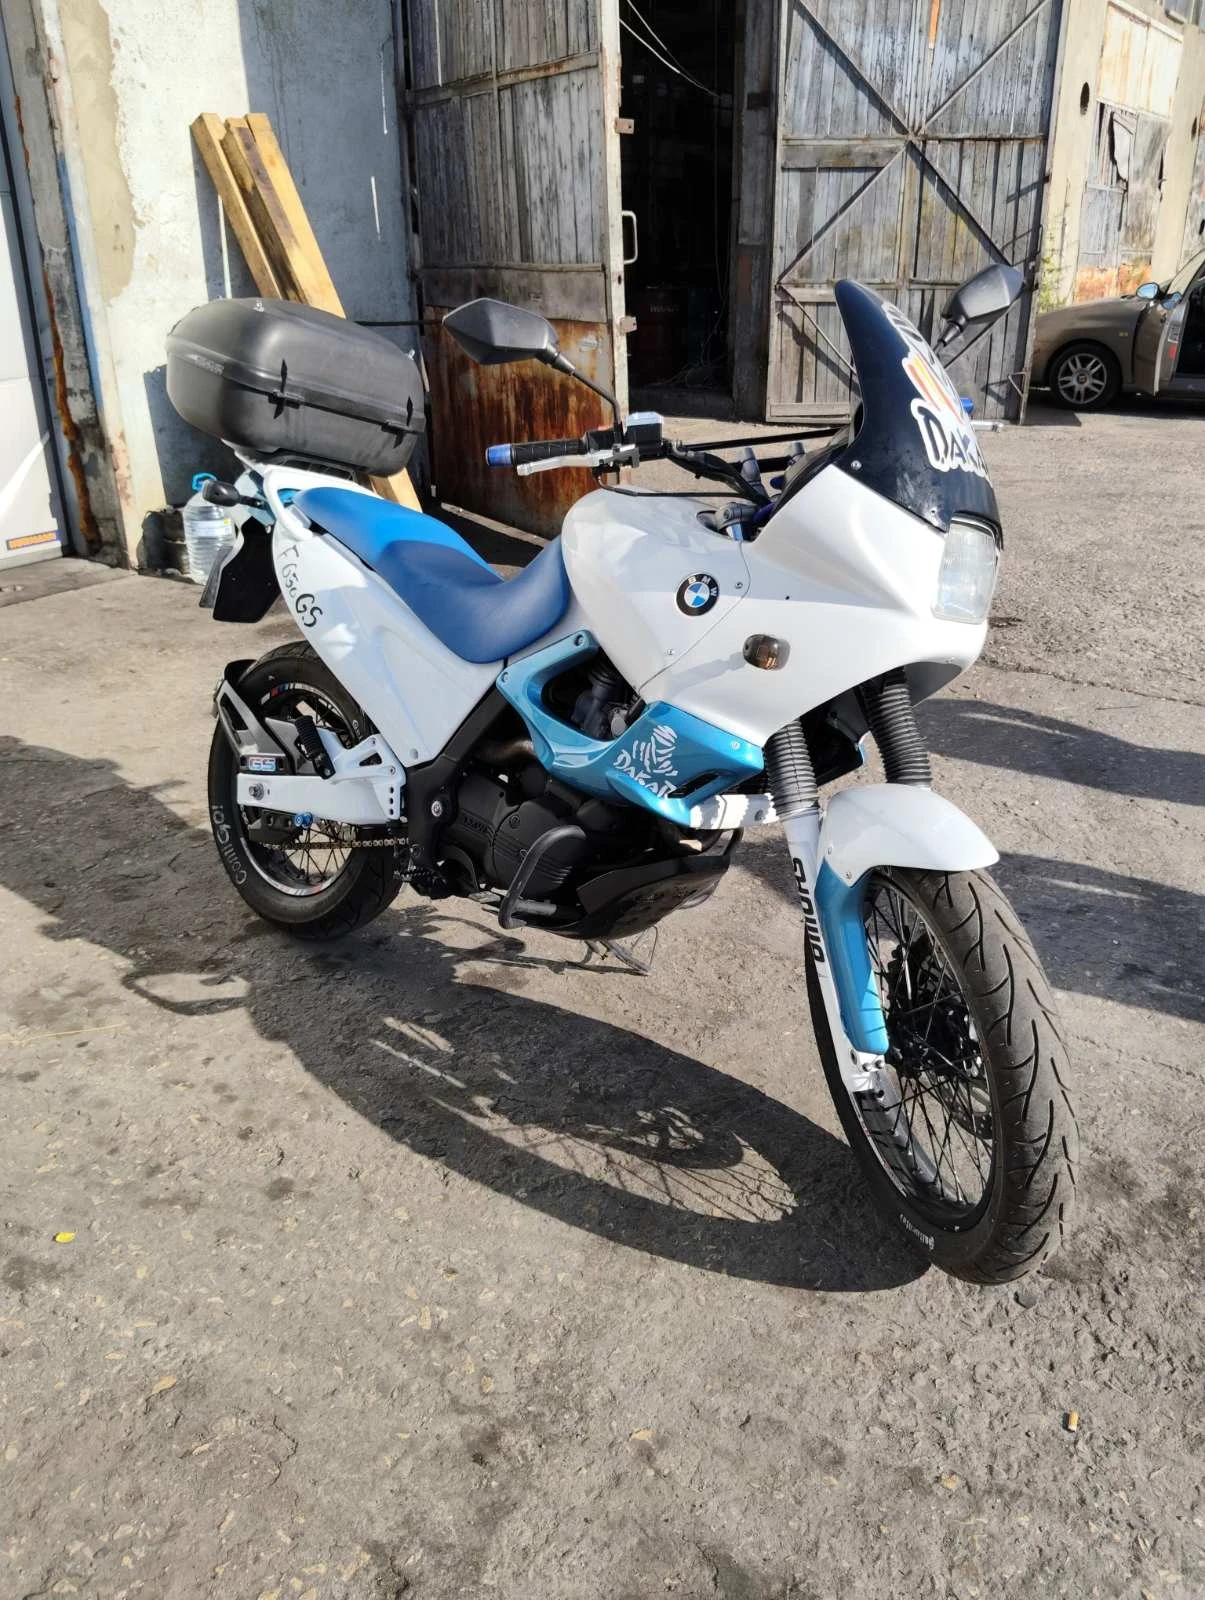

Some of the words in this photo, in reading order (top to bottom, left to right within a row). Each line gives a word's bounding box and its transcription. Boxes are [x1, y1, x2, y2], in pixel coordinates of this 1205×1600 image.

[296, 593, 323, 628] GS
[249, 757, 276, 771] GS
[613, 749, 678, 798] DAKAR
[793, 857, 825, 963] SHOWA
